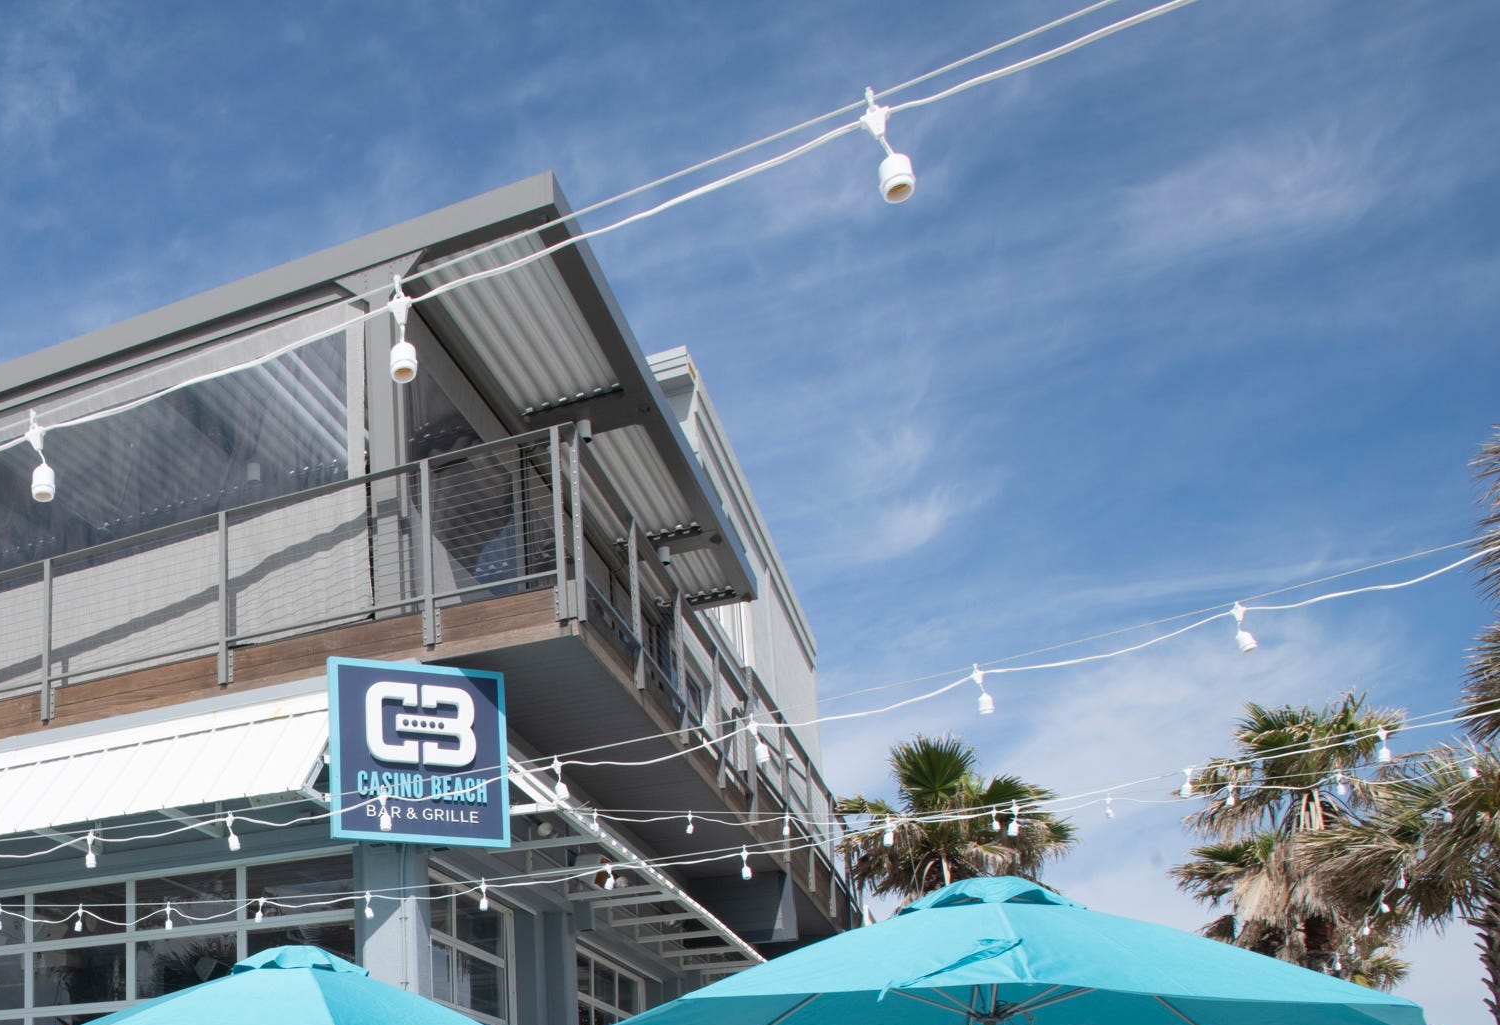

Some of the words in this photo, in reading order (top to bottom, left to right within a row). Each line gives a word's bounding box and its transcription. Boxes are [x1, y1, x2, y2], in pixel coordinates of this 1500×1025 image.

[357, 770, 423, 799] CASINO
[431, 775, 487, 803] BEACH
[366, 804, 401, 818] BAR
[406, 807, 418, 820] &
[422, 808, 479, 823] GRILLE
